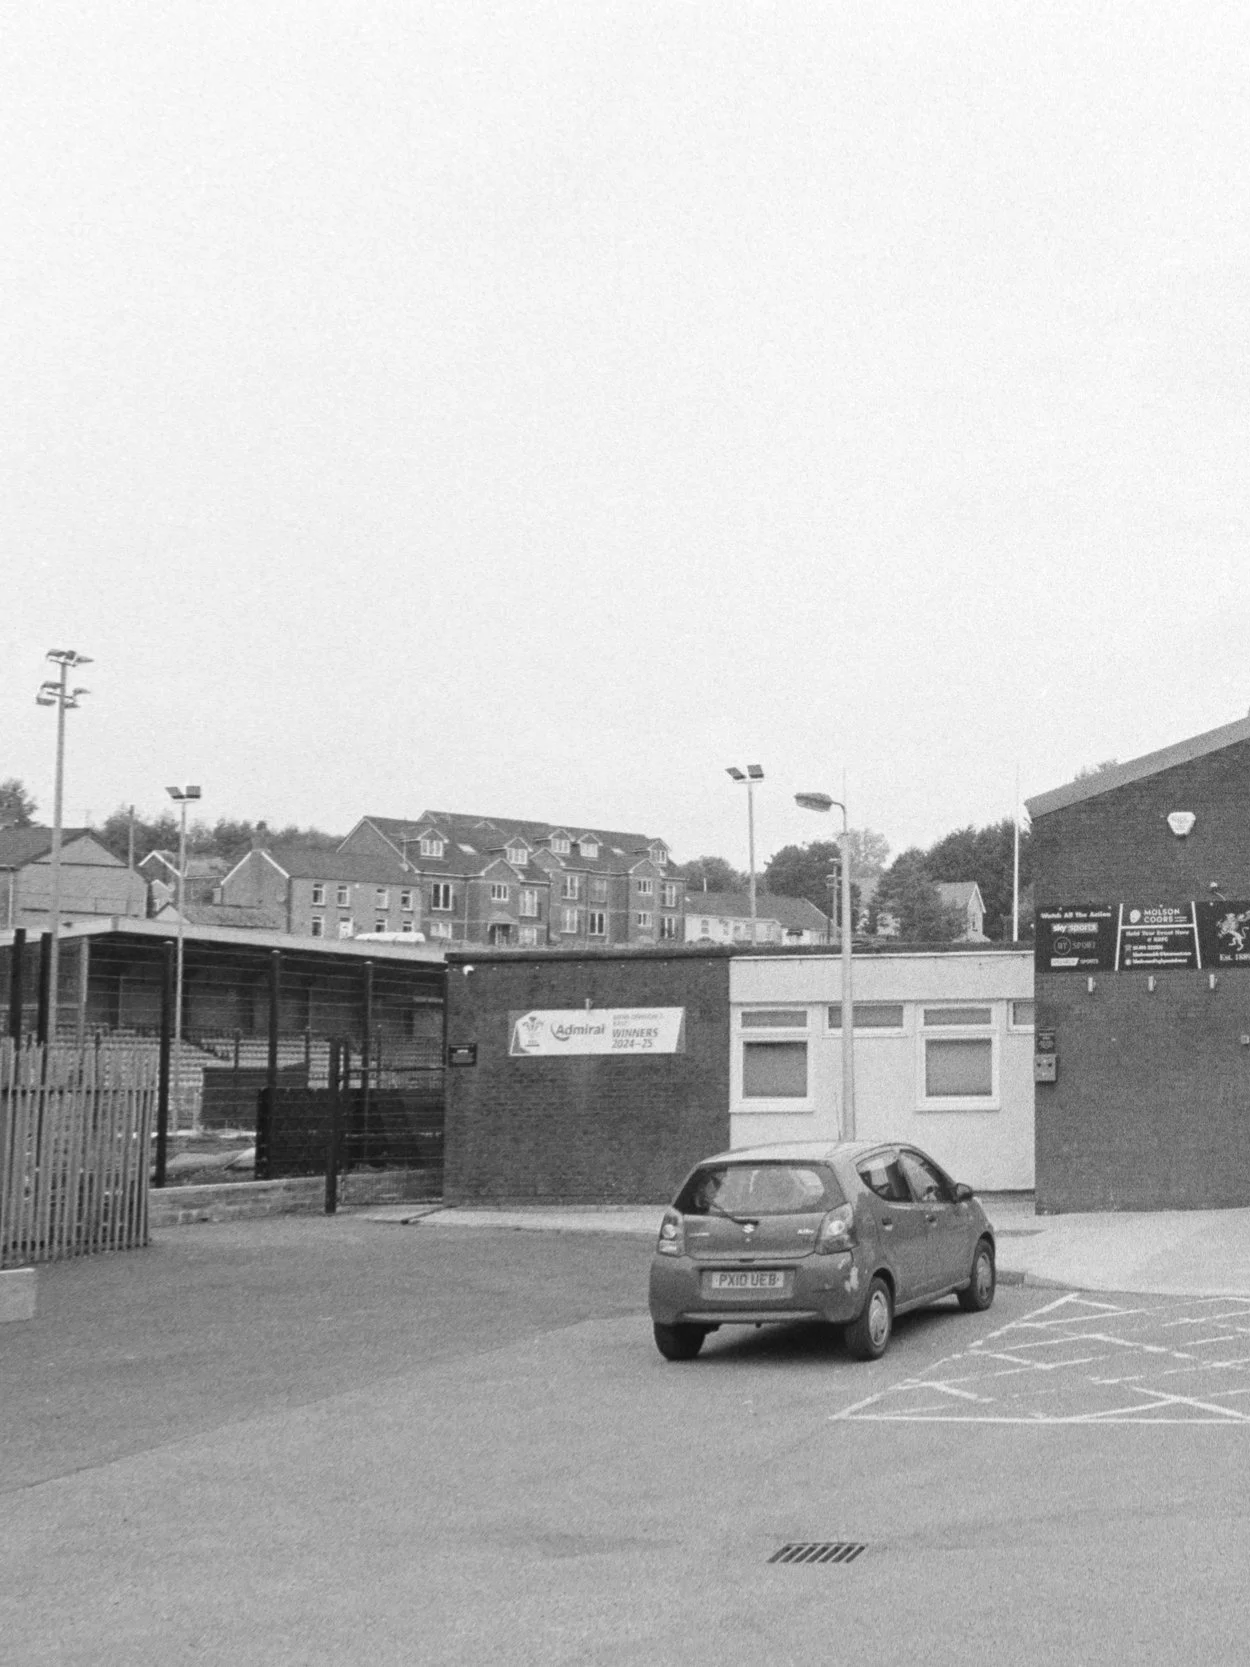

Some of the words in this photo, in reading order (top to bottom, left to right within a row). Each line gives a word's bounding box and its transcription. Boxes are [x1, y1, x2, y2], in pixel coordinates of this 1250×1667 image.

[1040, 911, 1062, 919] Watch
[1064, 911, 1074, 919] All
[1143, 908, 1180, 916] MOLSON
[1143, 916, 1174, 924] COORS
[1052, 923, 1067, 933] sky
[556, 1023, 605, 1036] Admiral
[612, 1027, 659, 1038] WINNERS
